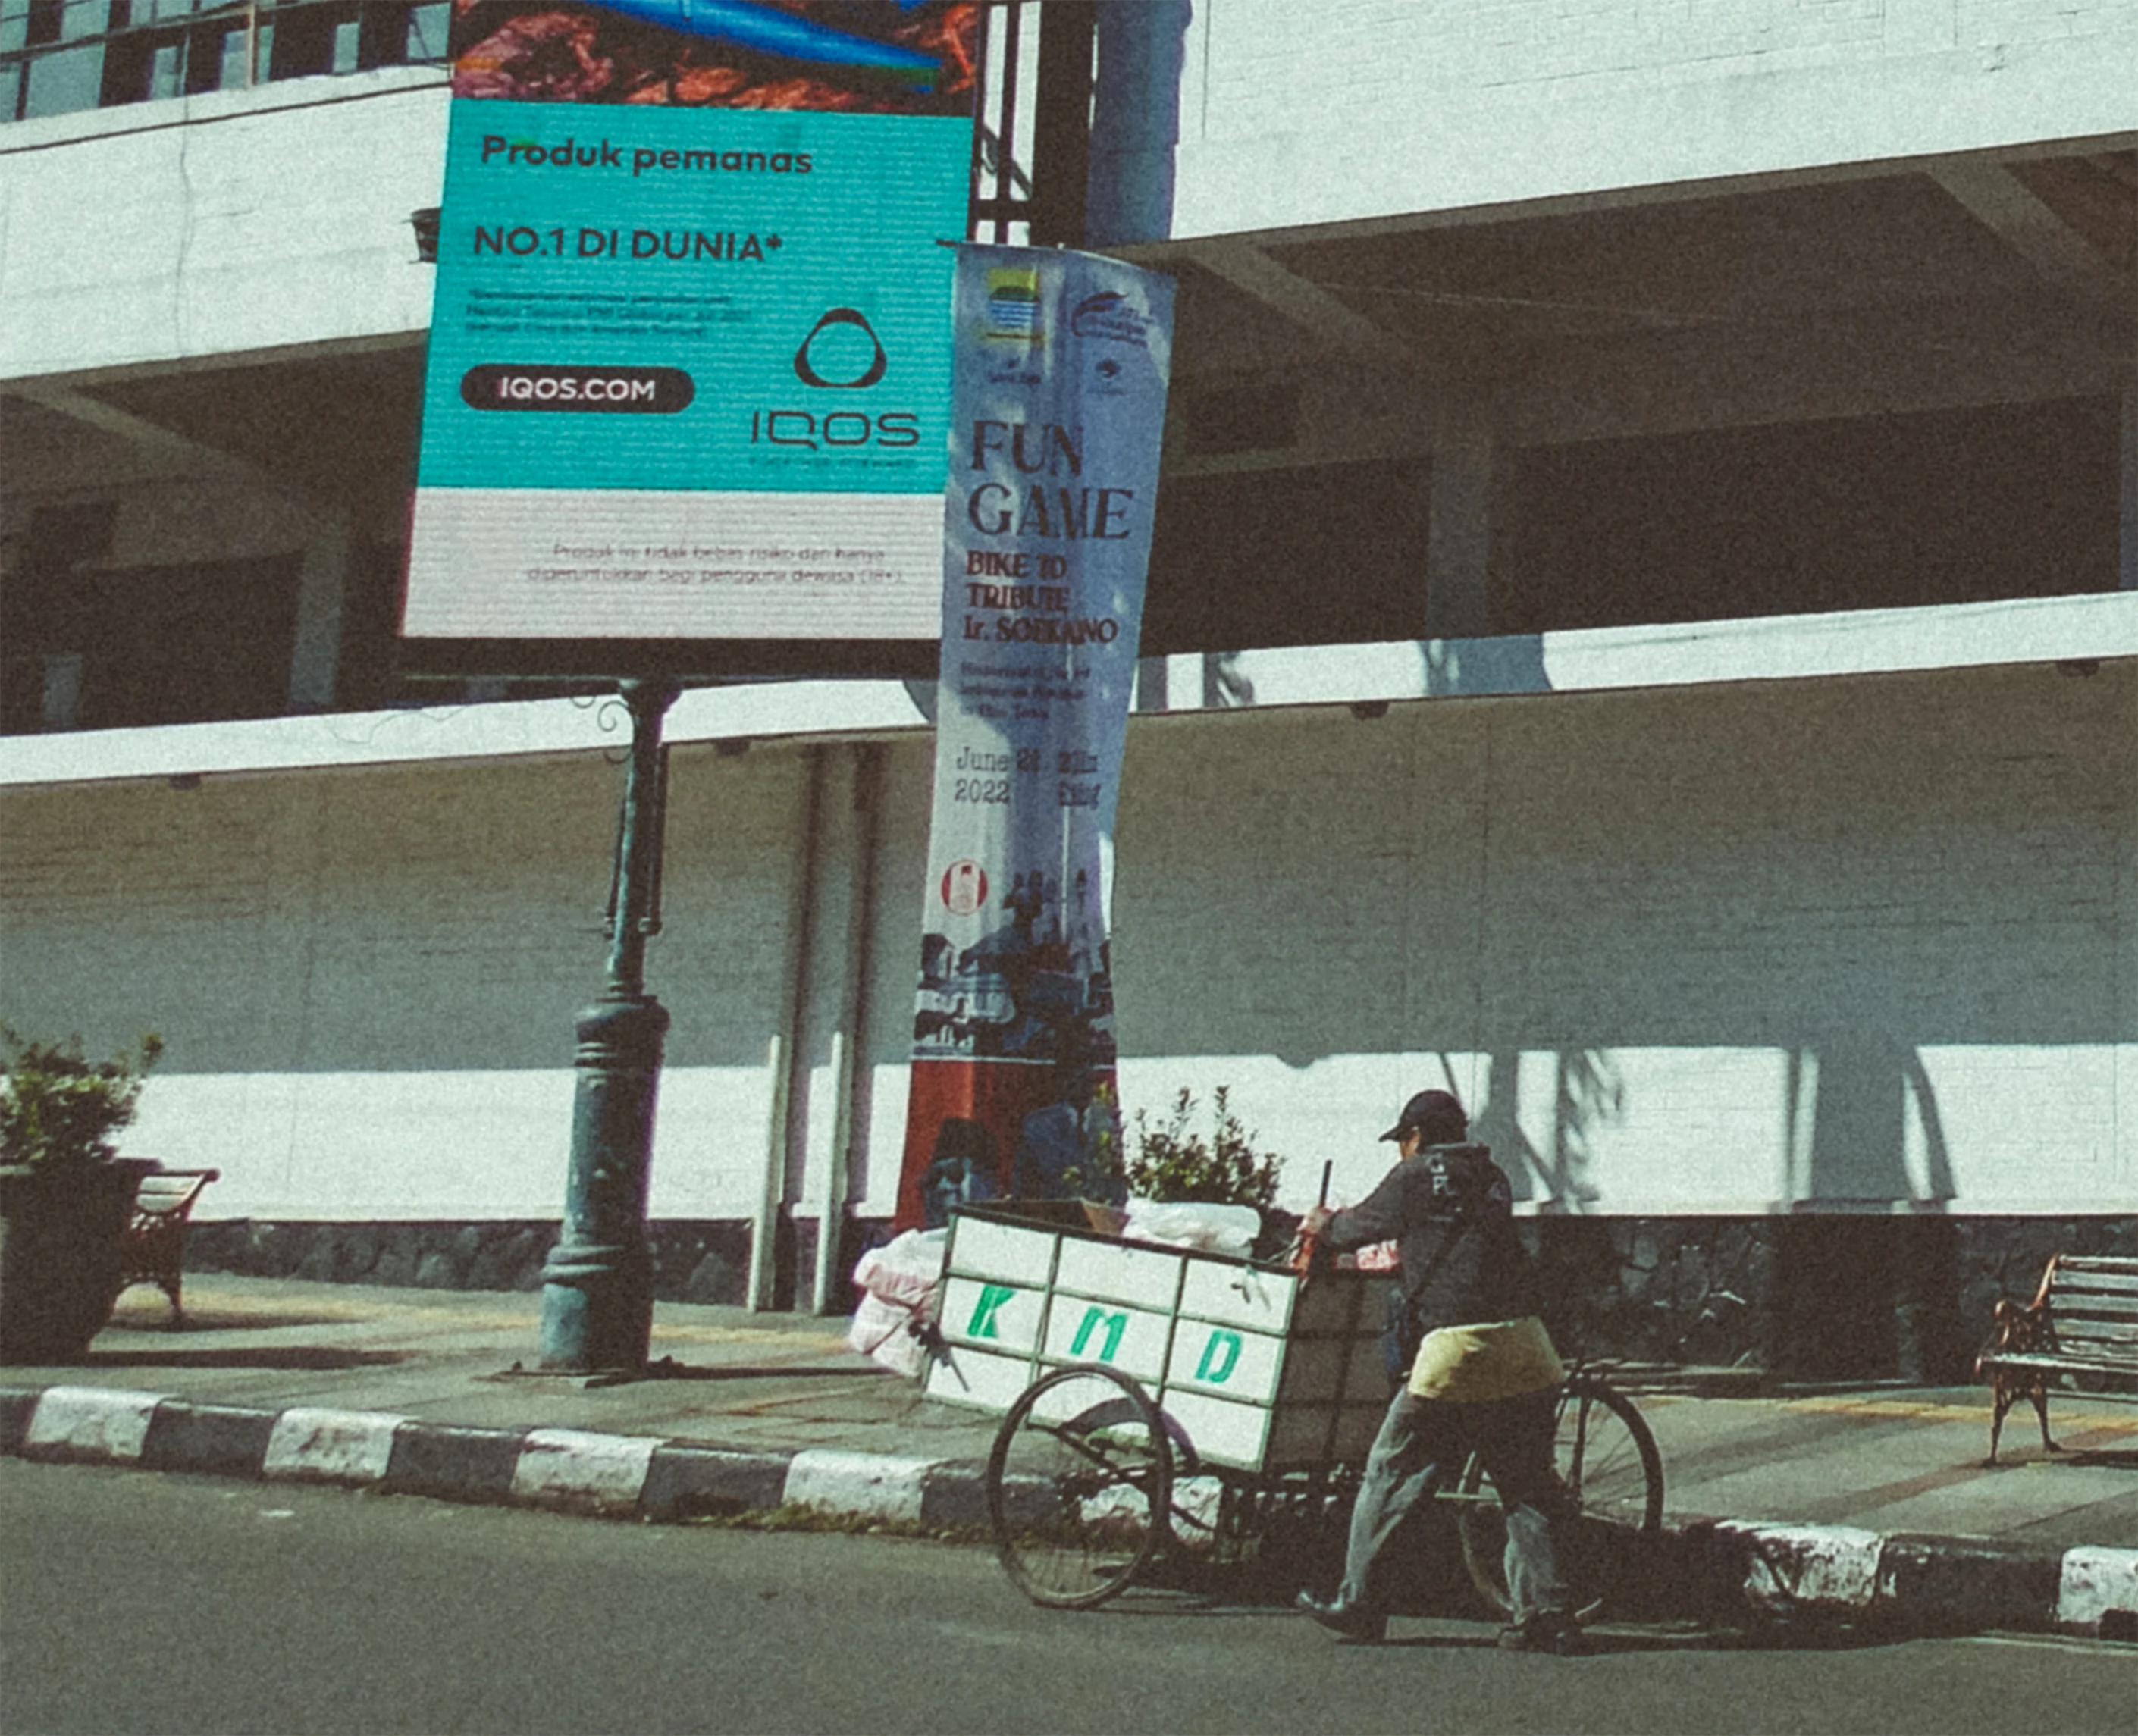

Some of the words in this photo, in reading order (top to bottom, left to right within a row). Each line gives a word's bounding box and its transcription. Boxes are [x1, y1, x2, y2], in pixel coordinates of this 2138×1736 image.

[481, 133, 623, 168] Produk
[632, 147, 813, 177] pemanas
[473, 224, 564, 257] NO.1
[577, 227, 619, 259] DI
[500, 376, 657, 401] IQOS.COM
[751, 410, 920, 450] IQOS
[970, 420, 1084, 478] FUN
[965, 549, 1031, 580] BIKE
[1036, 553, 1068, 581] TO
[956, 745, 1011, 773] June
[954, 778, 1011, 805] 2022
